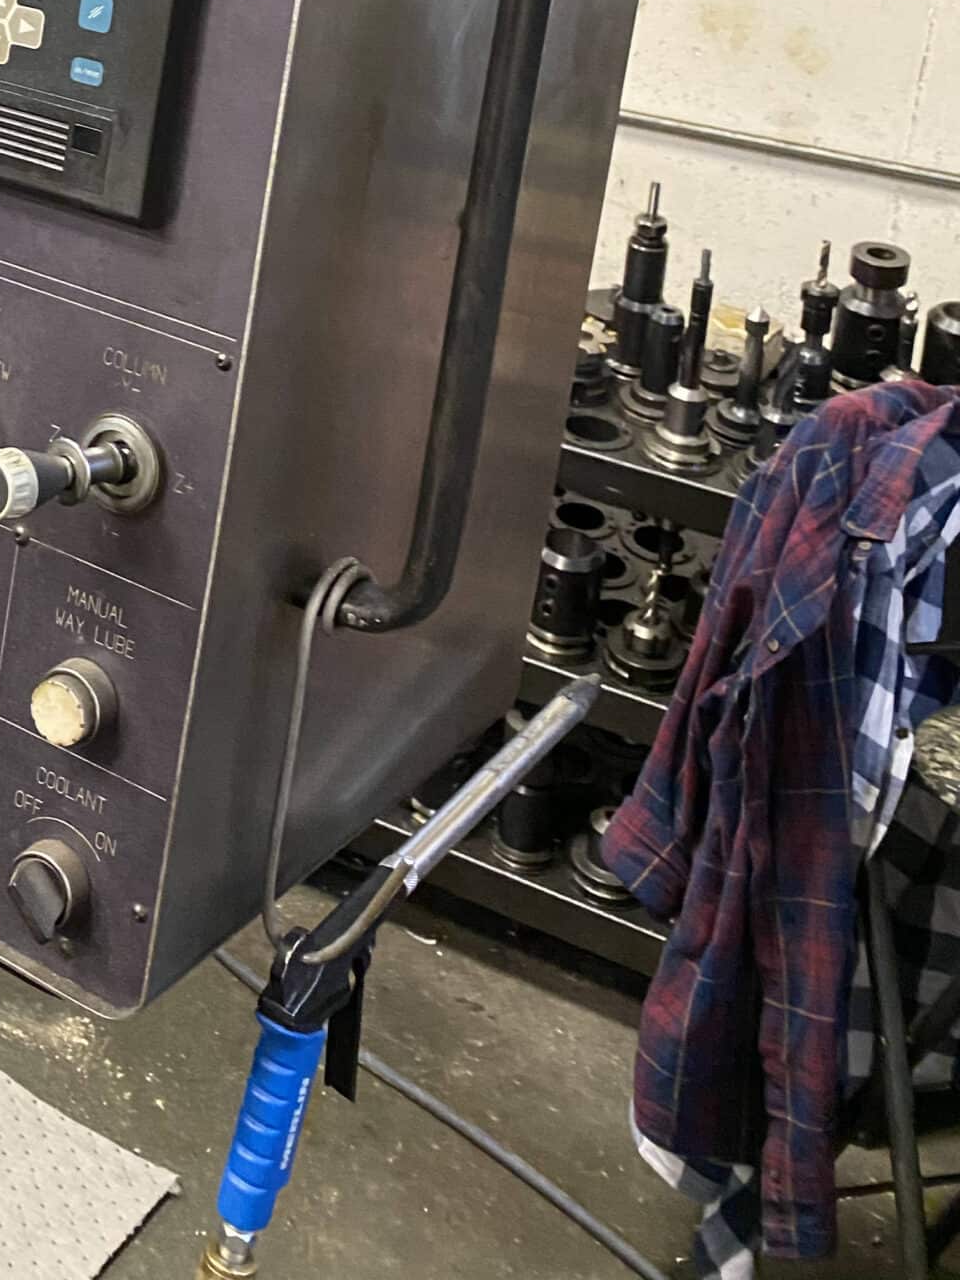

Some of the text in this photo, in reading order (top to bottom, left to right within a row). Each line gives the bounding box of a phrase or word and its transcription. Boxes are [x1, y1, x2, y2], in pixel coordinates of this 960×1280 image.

[67, 585, 129, 629] MANUAL
[55, 607, 136, 660] WAY LUBE
[14, 789, 44, 815] OFF
[36, 765, 108, 815] COOLANT
[94, 831, 117, 857] ON
